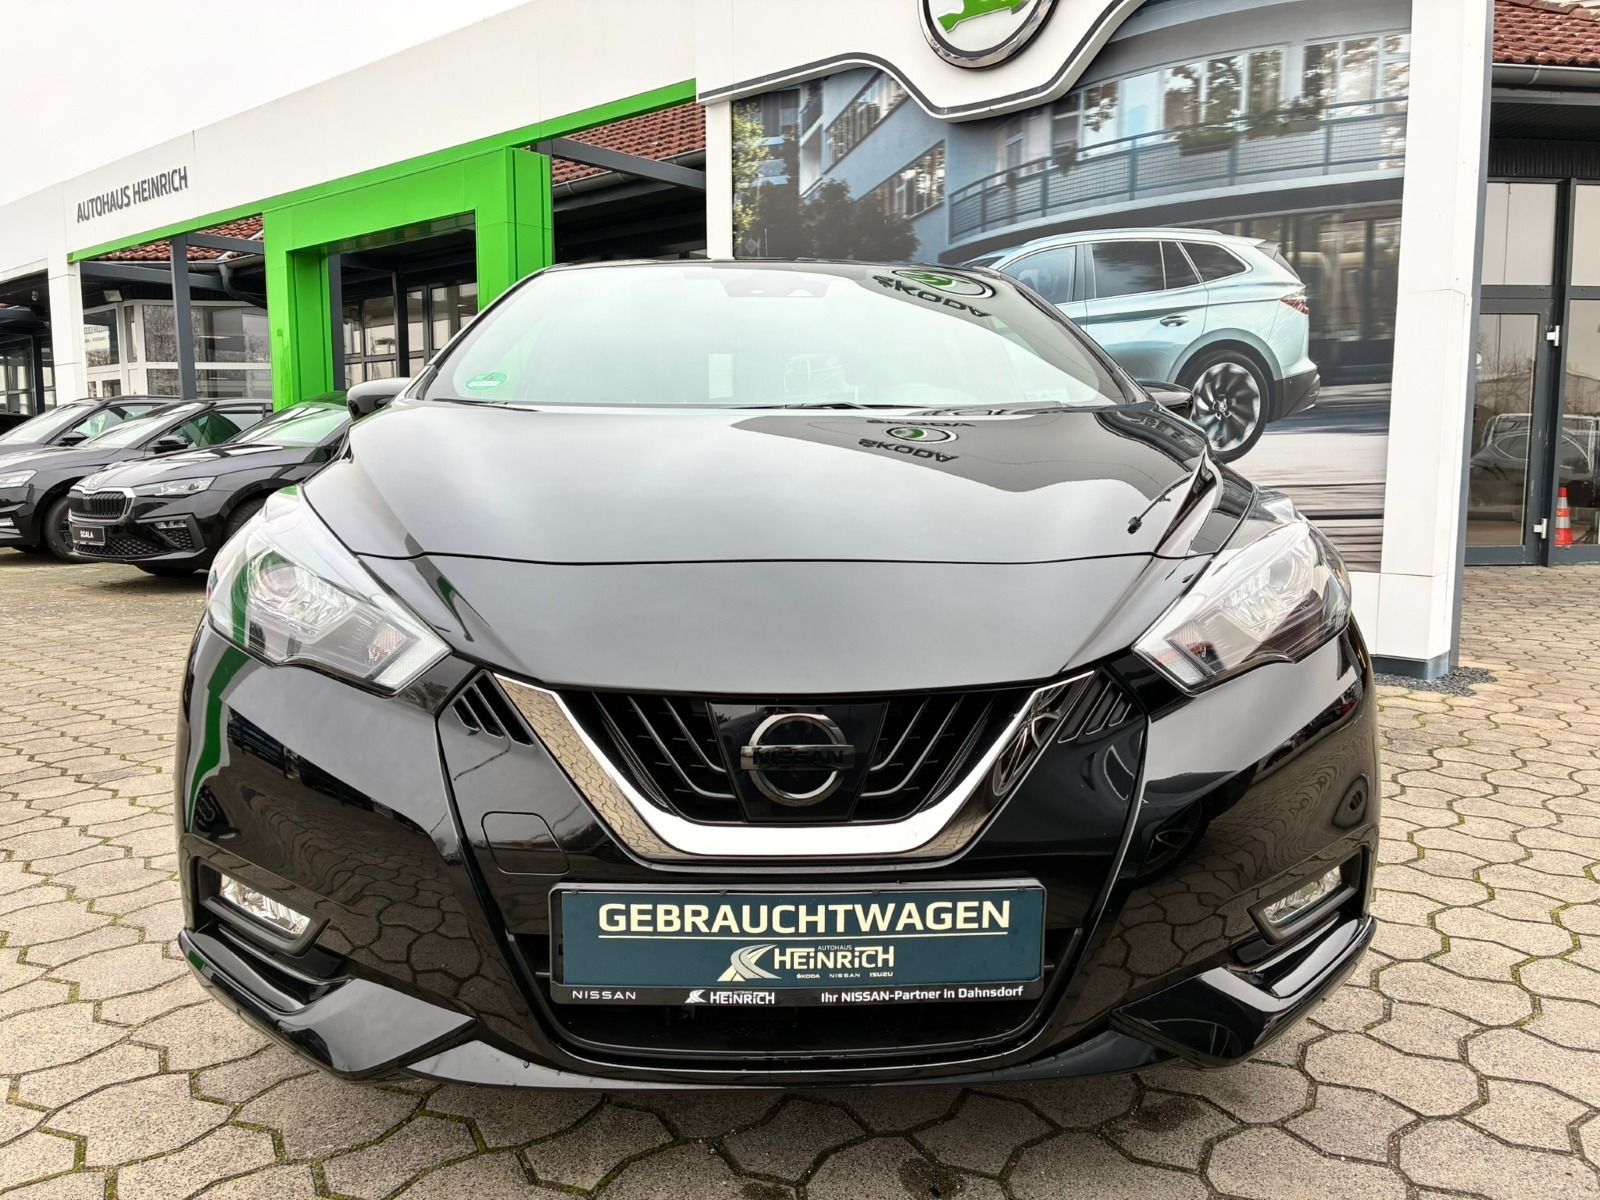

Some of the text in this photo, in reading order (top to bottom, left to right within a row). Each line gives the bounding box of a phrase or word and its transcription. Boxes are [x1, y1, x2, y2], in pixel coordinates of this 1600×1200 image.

[77, 166, 188, 223] AUTOHAUS HEINRICH
[752, 748, 843, 765] NISSAN
[598, 900, 1010, 934] GEBRAUCHTWAGEN
[572, 990, 637, 1000] NISSAN
[821, 985, 1024, 1003] Ihr NISSAN-Partner in Dahnsdorf
